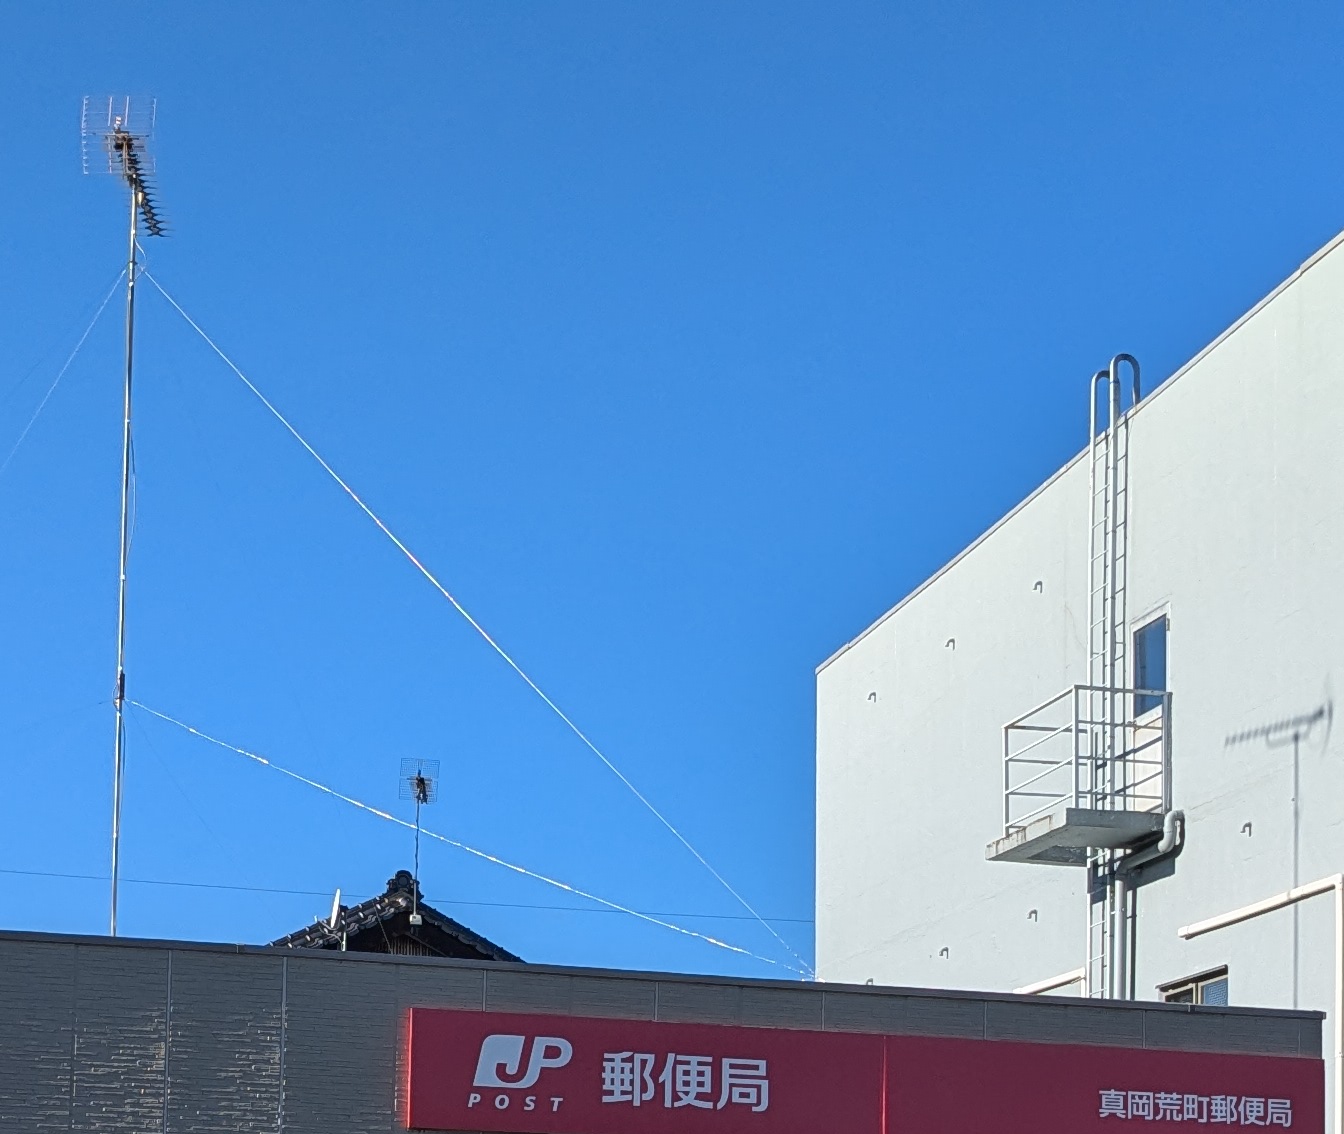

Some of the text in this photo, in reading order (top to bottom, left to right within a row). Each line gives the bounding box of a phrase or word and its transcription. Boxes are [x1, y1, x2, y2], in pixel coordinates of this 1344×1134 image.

[601, 1051, 769, 1112] 郵便局
[467, 1093, 563, 1111] POST
[1098, 1089, 1293, 1128] 真岡荒町郵便局
